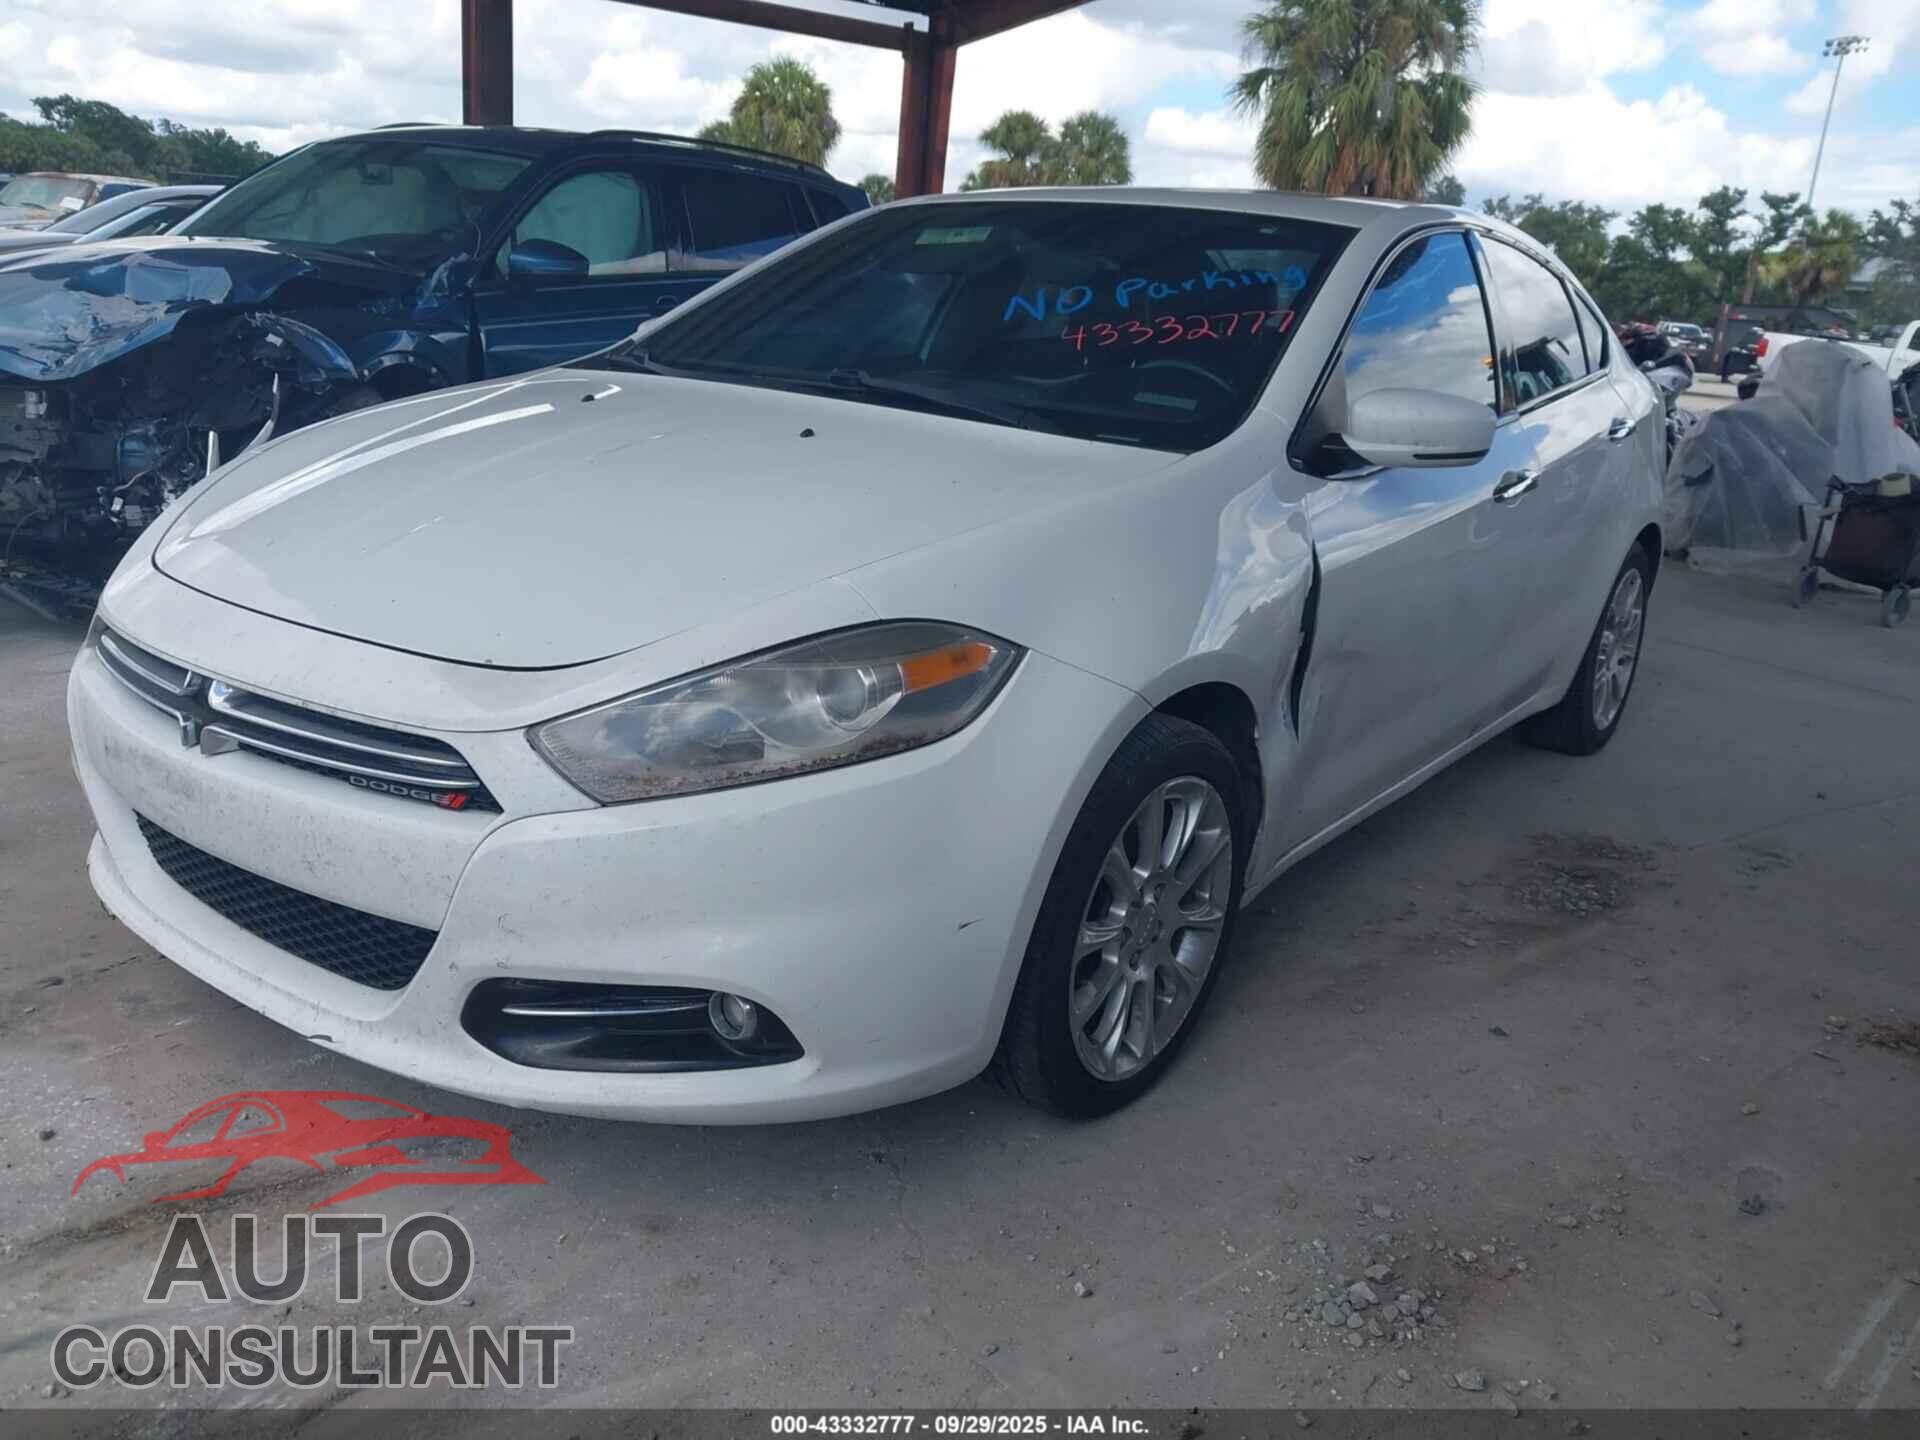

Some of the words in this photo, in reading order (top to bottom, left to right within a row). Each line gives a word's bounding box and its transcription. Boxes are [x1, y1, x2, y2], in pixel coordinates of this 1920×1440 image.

[1003, 285, 1093, 321] NO
[1115, 264, 1309, 308] Parking
[1061, 310, 1296, 352] 43332777
[349, 774, 451, 808] DODGE
